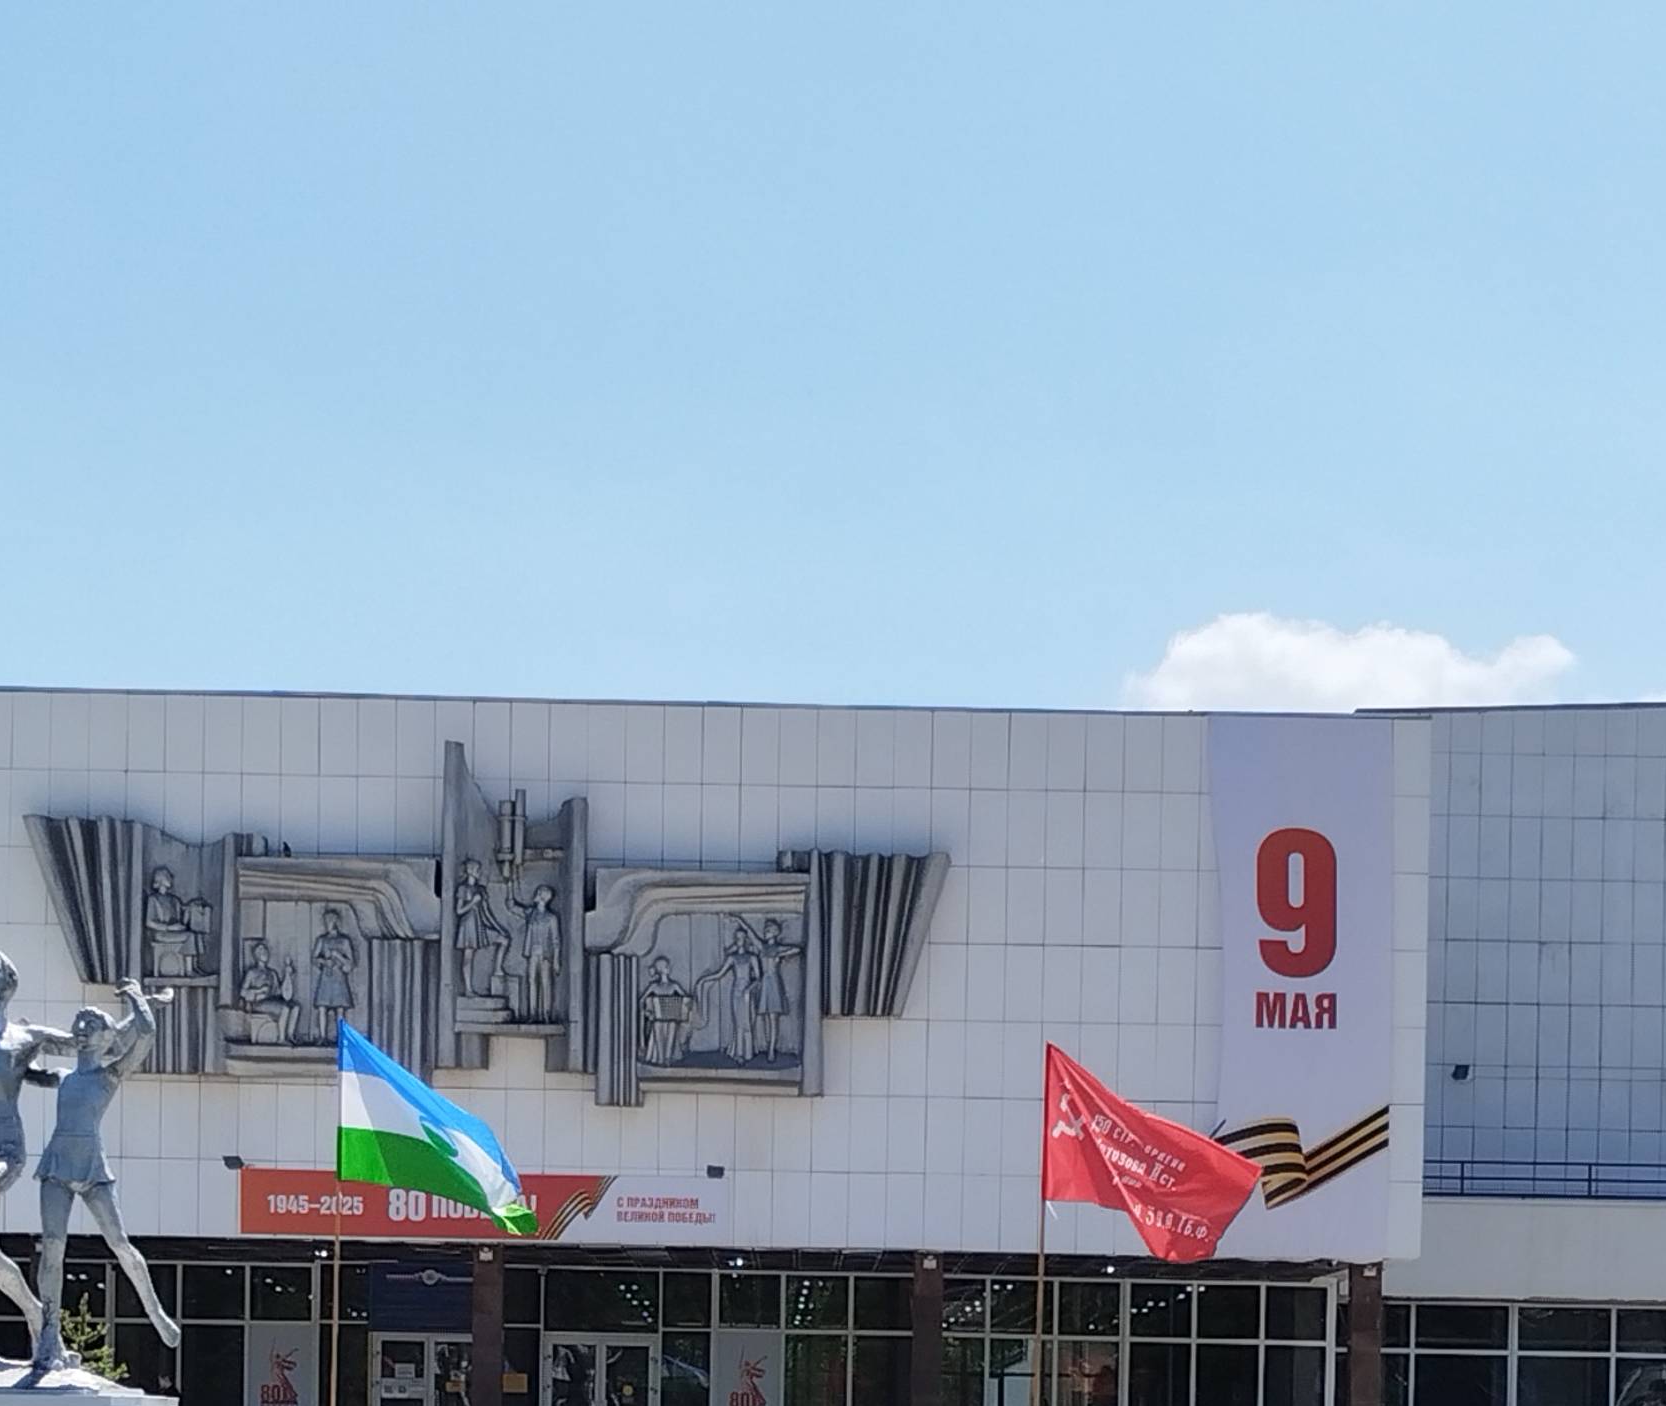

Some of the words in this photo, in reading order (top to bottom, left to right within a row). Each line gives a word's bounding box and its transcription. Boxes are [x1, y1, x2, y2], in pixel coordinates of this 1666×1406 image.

[1256, 827, 1337, 978] 9
[1255, 991, 1337, 1029] МАЯ
[388, 1188, 426, 1221] 80
[616, 1197, 624, 1208] С
[627, 1197, 699, 1209] ПРАЗДНИКОМ
[616, 1211, 665, 1223] ВЕЛИКОЙ
